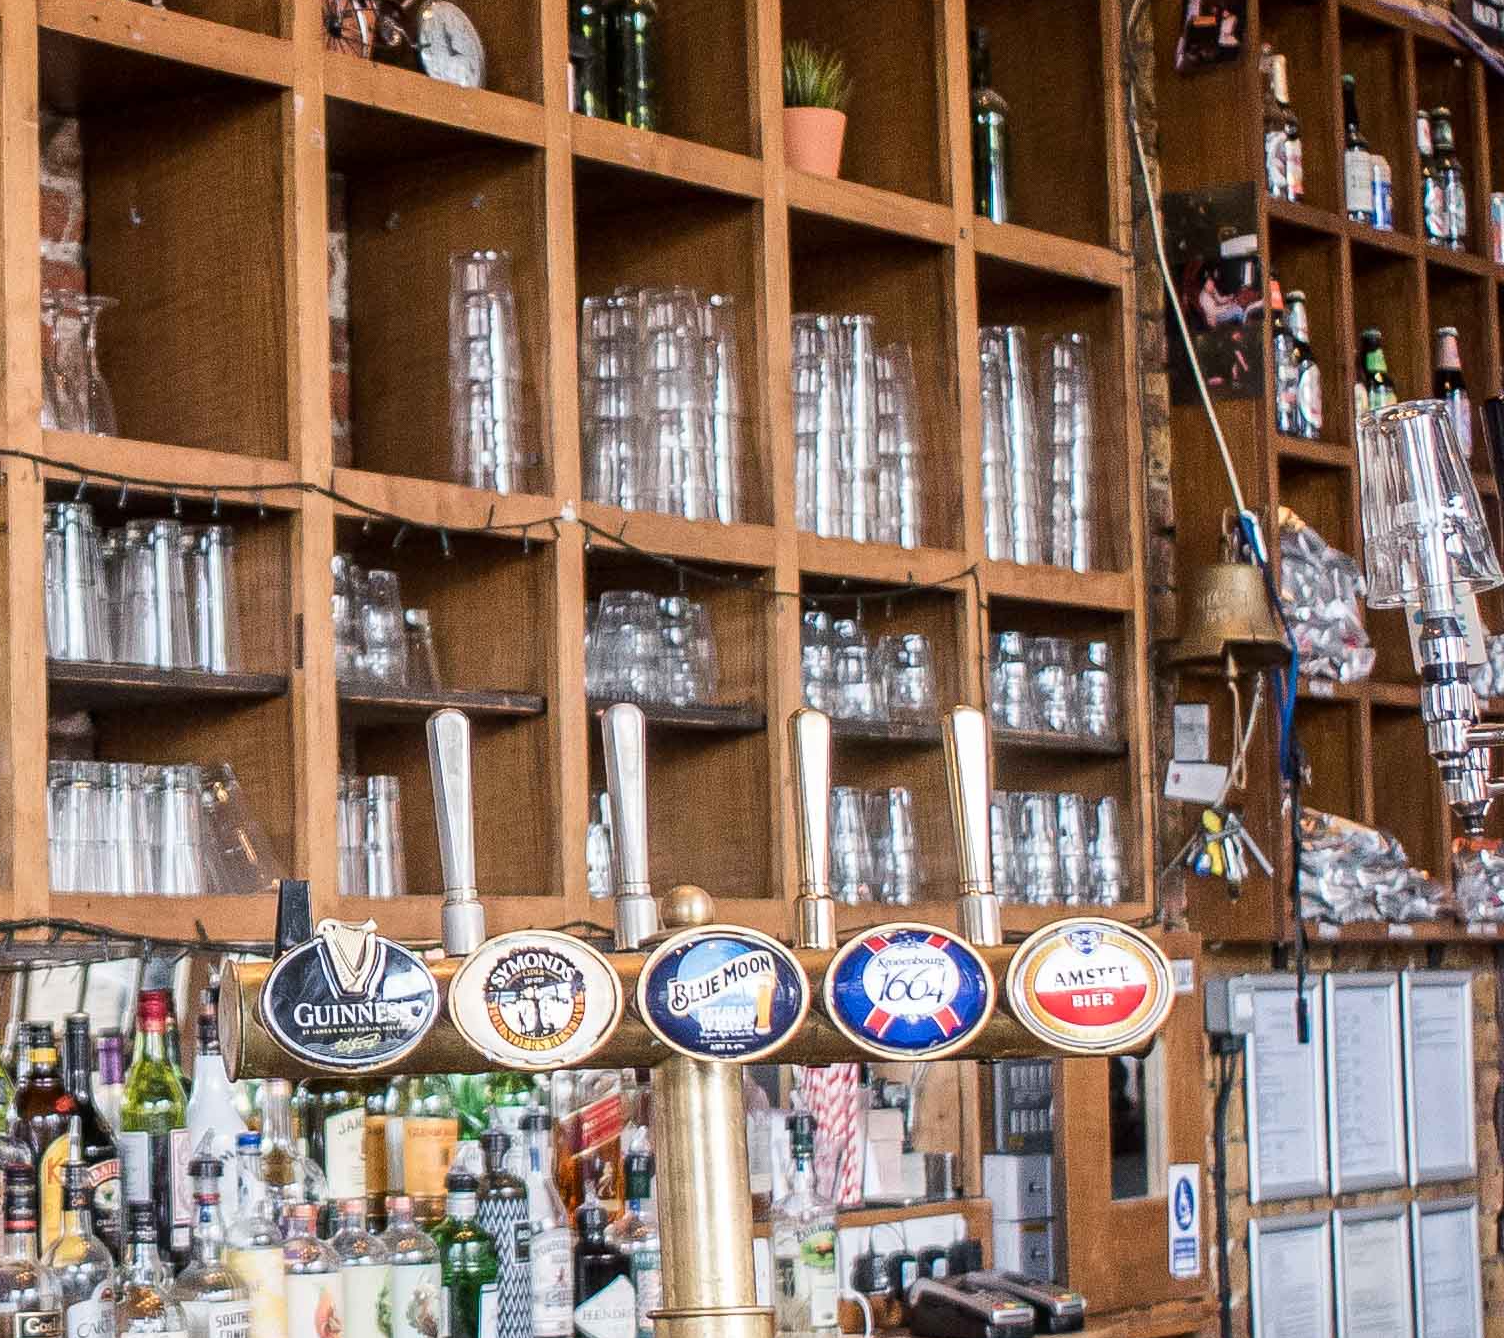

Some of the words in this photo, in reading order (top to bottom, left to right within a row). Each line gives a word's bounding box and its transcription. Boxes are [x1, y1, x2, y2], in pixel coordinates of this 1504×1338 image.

[490, 952, 577, 990] SYMONDS
[669, 976, 721, 1012] BLUE
[722, 955, 772, 988] MOON
[877, 968, 946, 1004] 1664
[1071, 992, 1115, 1008] BIER
